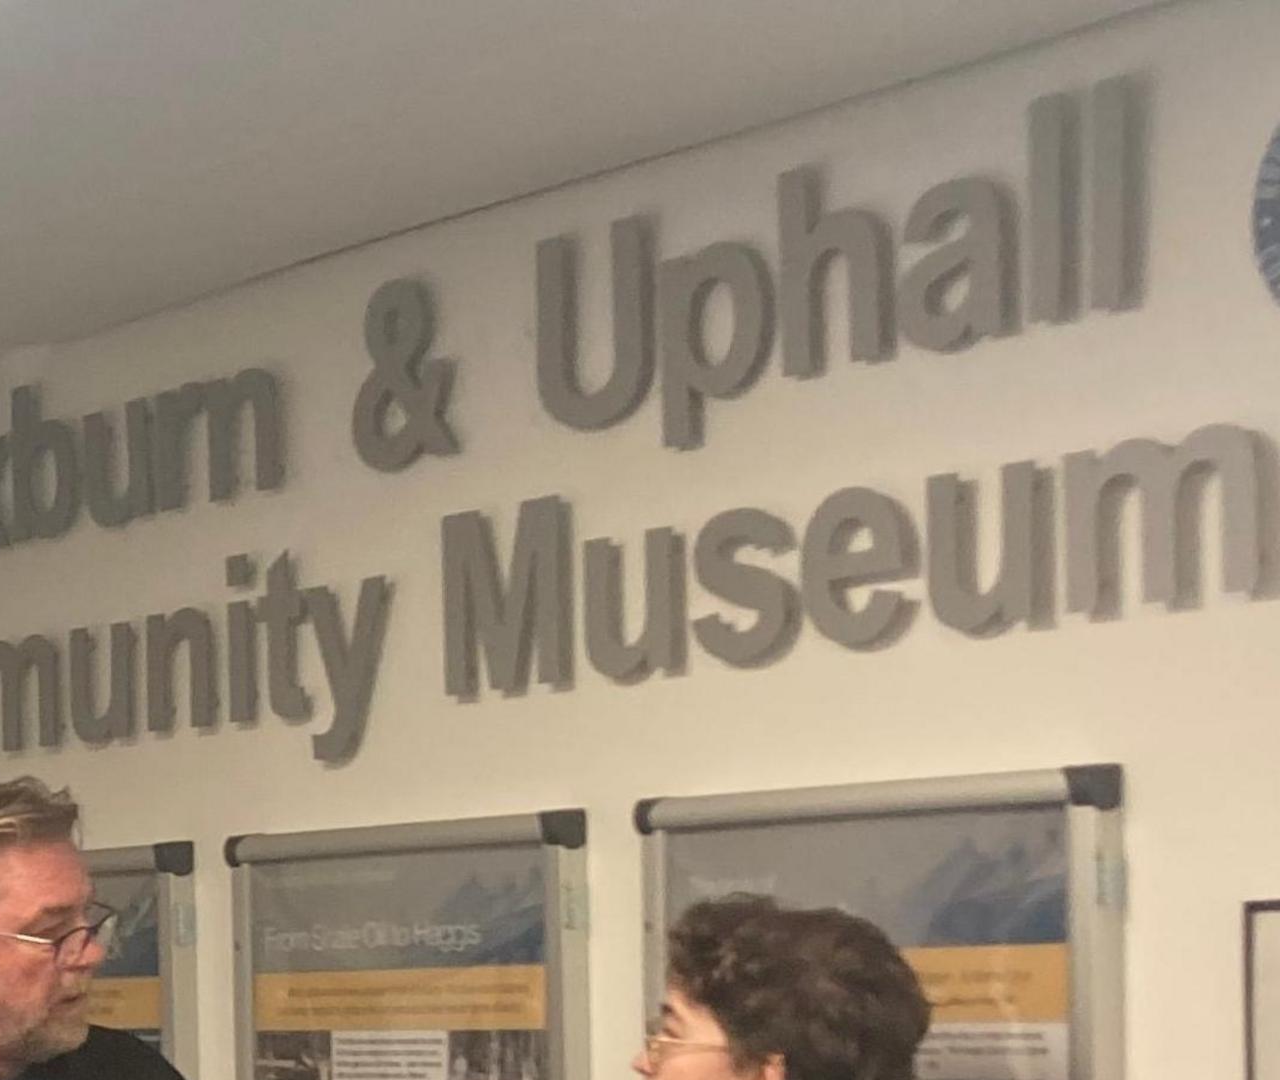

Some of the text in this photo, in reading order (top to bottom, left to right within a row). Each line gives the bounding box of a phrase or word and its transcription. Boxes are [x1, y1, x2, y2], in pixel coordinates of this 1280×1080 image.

[352, 275, 460, 473] &
[536, 73, 1153, 452] Uphall
[442, 423, 1280, 704] Museum
